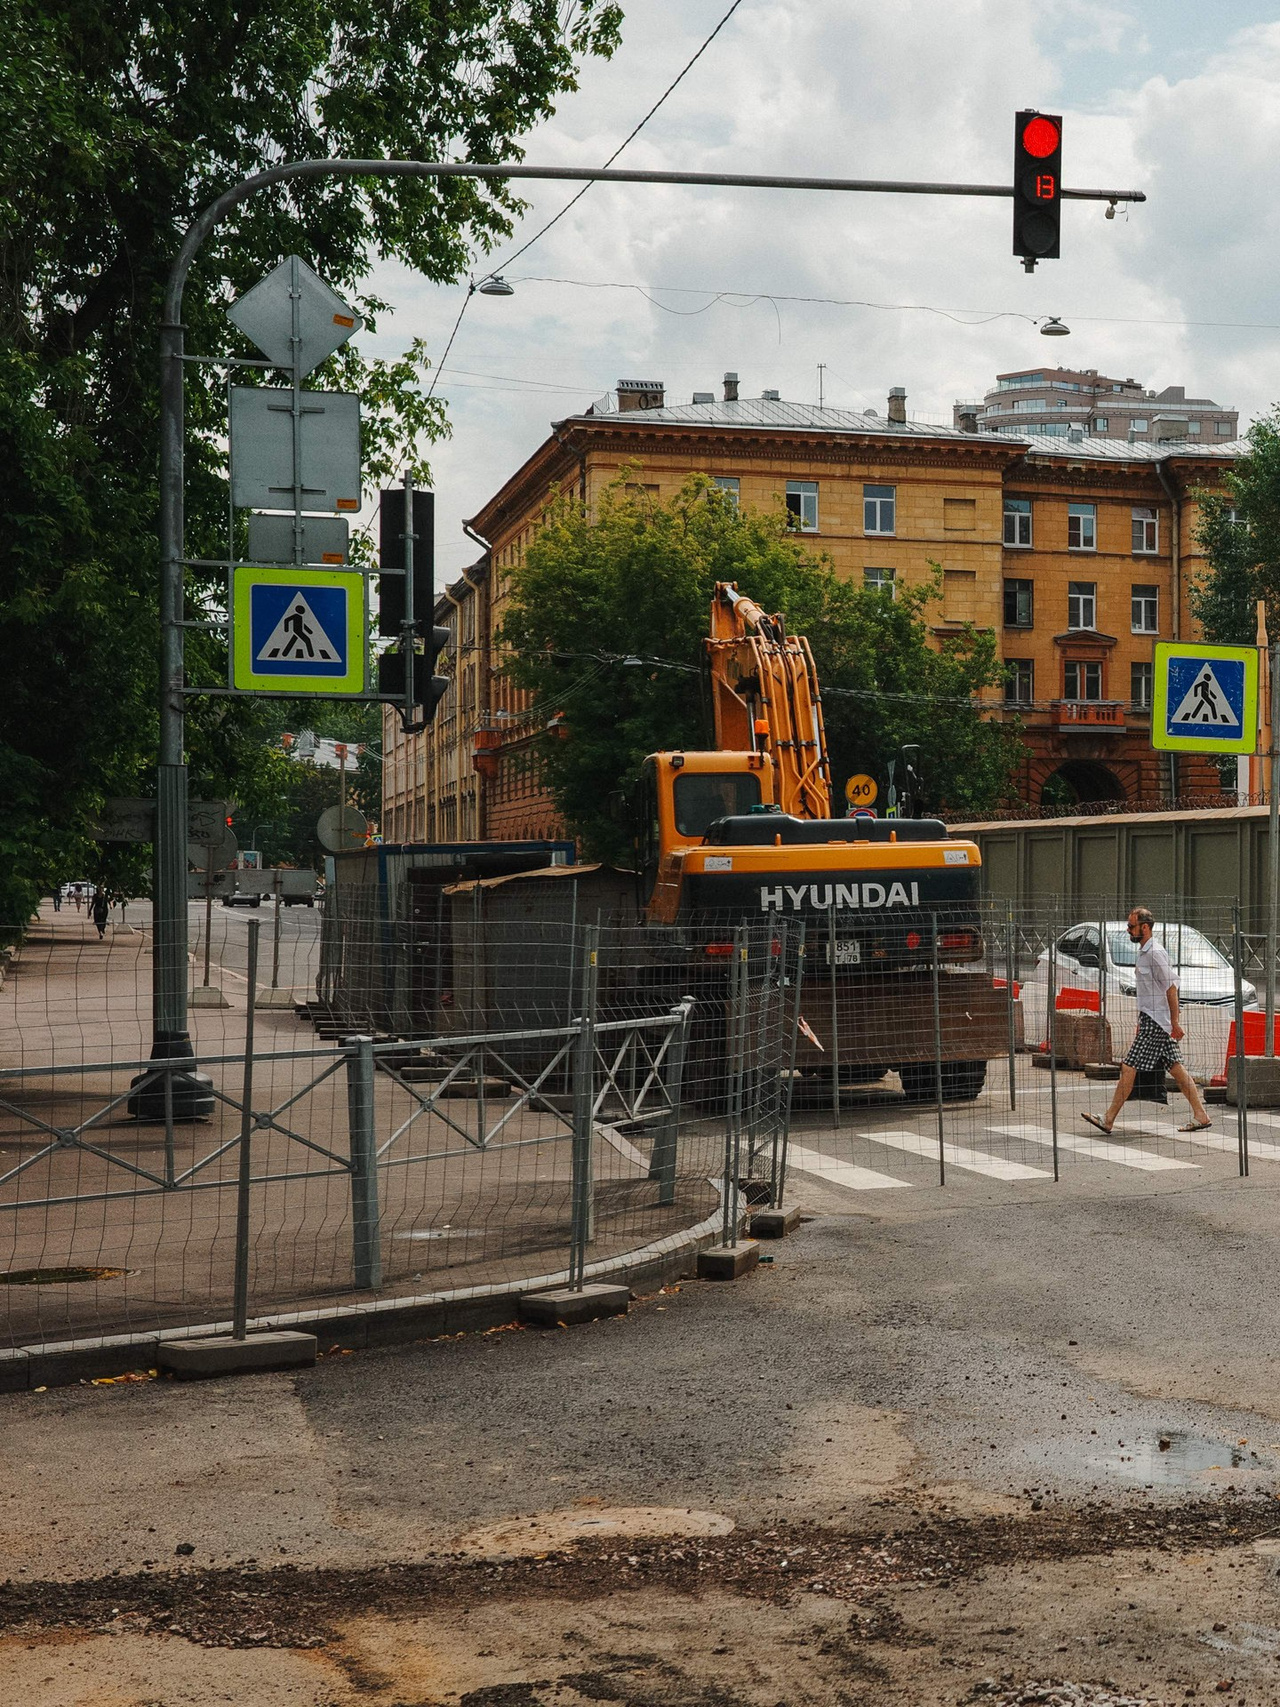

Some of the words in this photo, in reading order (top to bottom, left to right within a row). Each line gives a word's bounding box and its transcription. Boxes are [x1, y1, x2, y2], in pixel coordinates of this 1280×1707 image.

[1035, 175, 1055, 200] 13
[852, 784, 871, 797] 40
[760, 881, 919, 912] HYUNDAI
[831, 941, 856, 952] 851
[847, 954, 858, 963] 78
